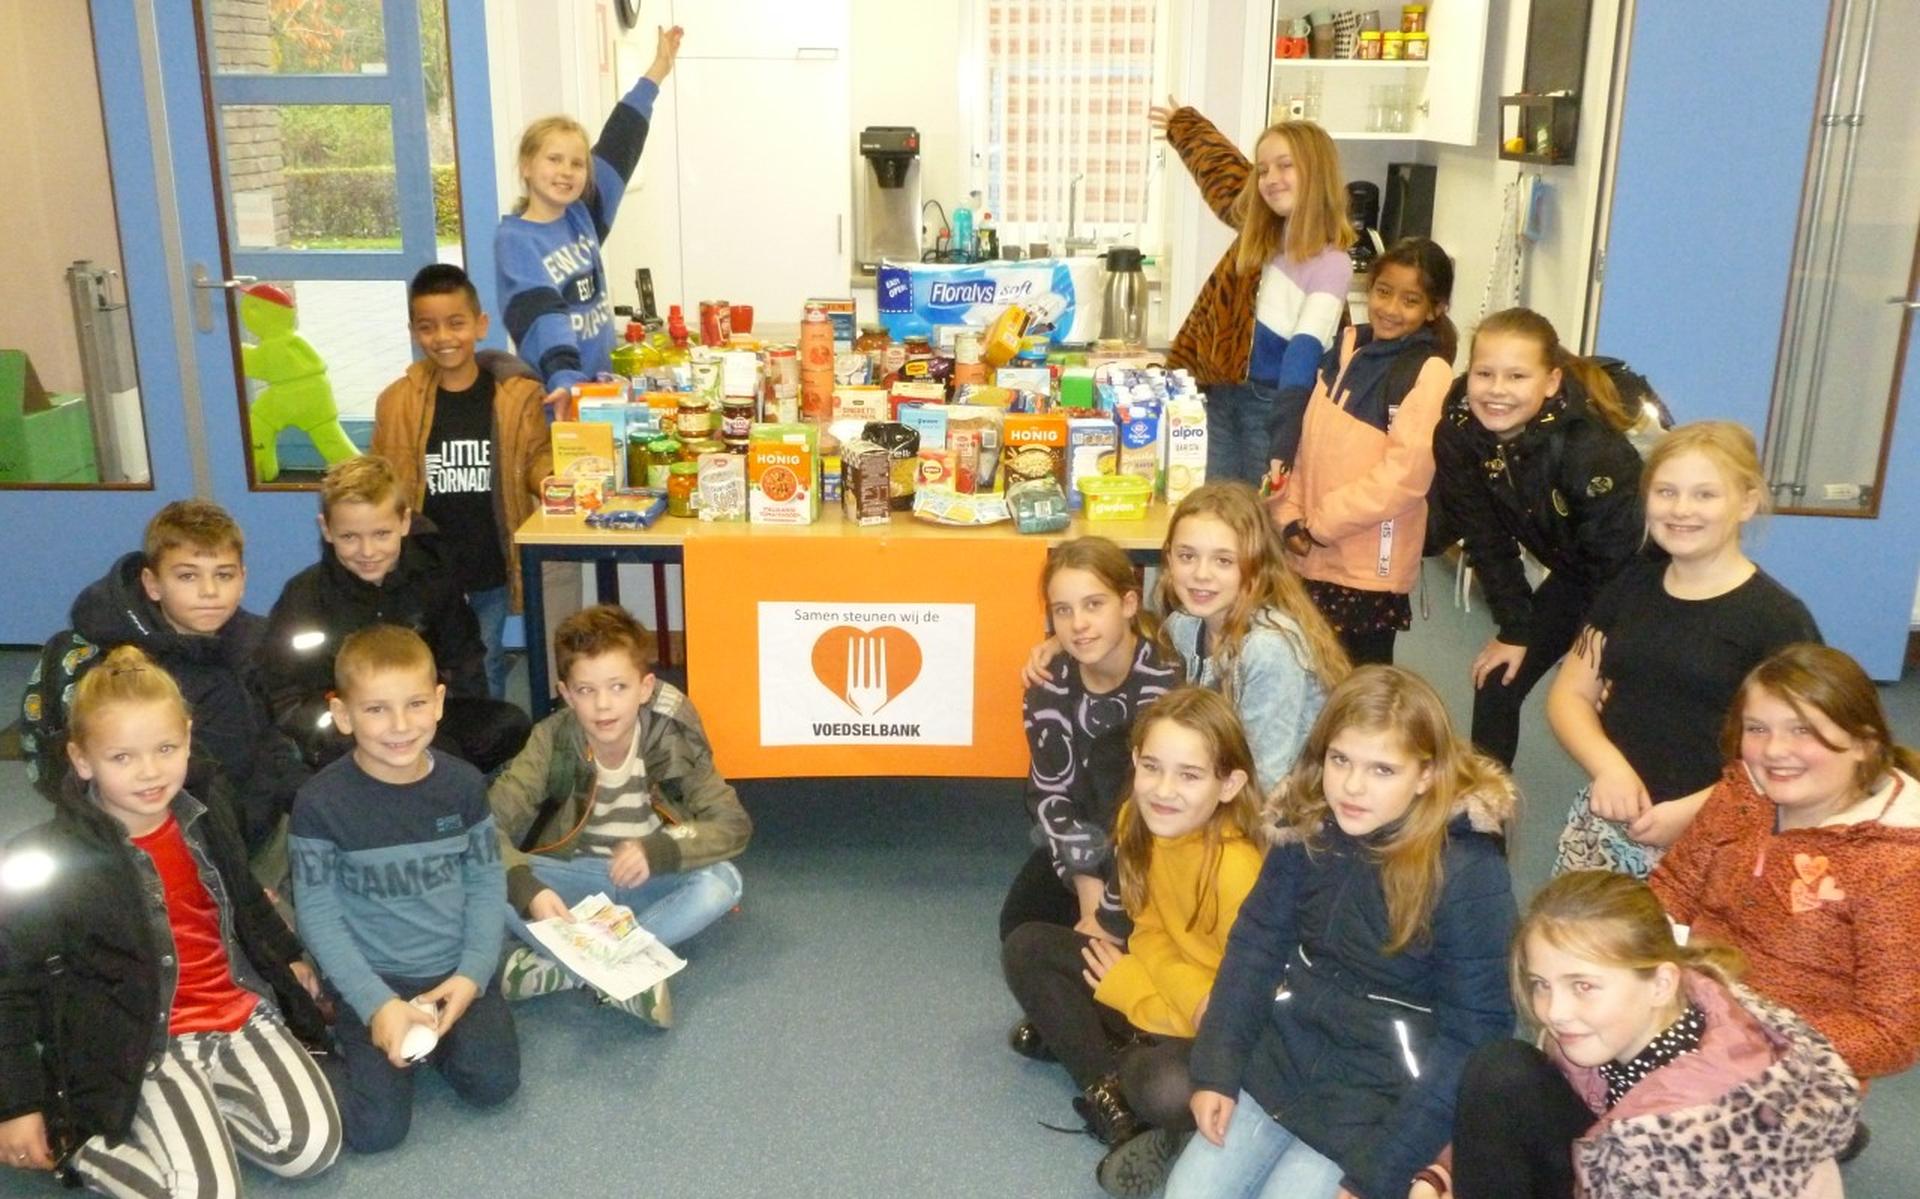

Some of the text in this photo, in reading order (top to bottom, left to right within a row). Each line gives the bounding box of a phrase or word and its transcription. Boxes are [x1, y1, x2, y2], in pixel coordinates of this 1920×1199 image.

[931, 282, 995, 304] Floralys
[1011, 430, 1058, 441] HONIG
[1172, 426, 1204, 439] alpro
[442, 439, 491, 467] LITTLE
[757, 454, 800, 465] HONIG
[794, 608, 940, 625] Samen steunen wij de
[812, 722, 921, 737] VOEDSELBANK
